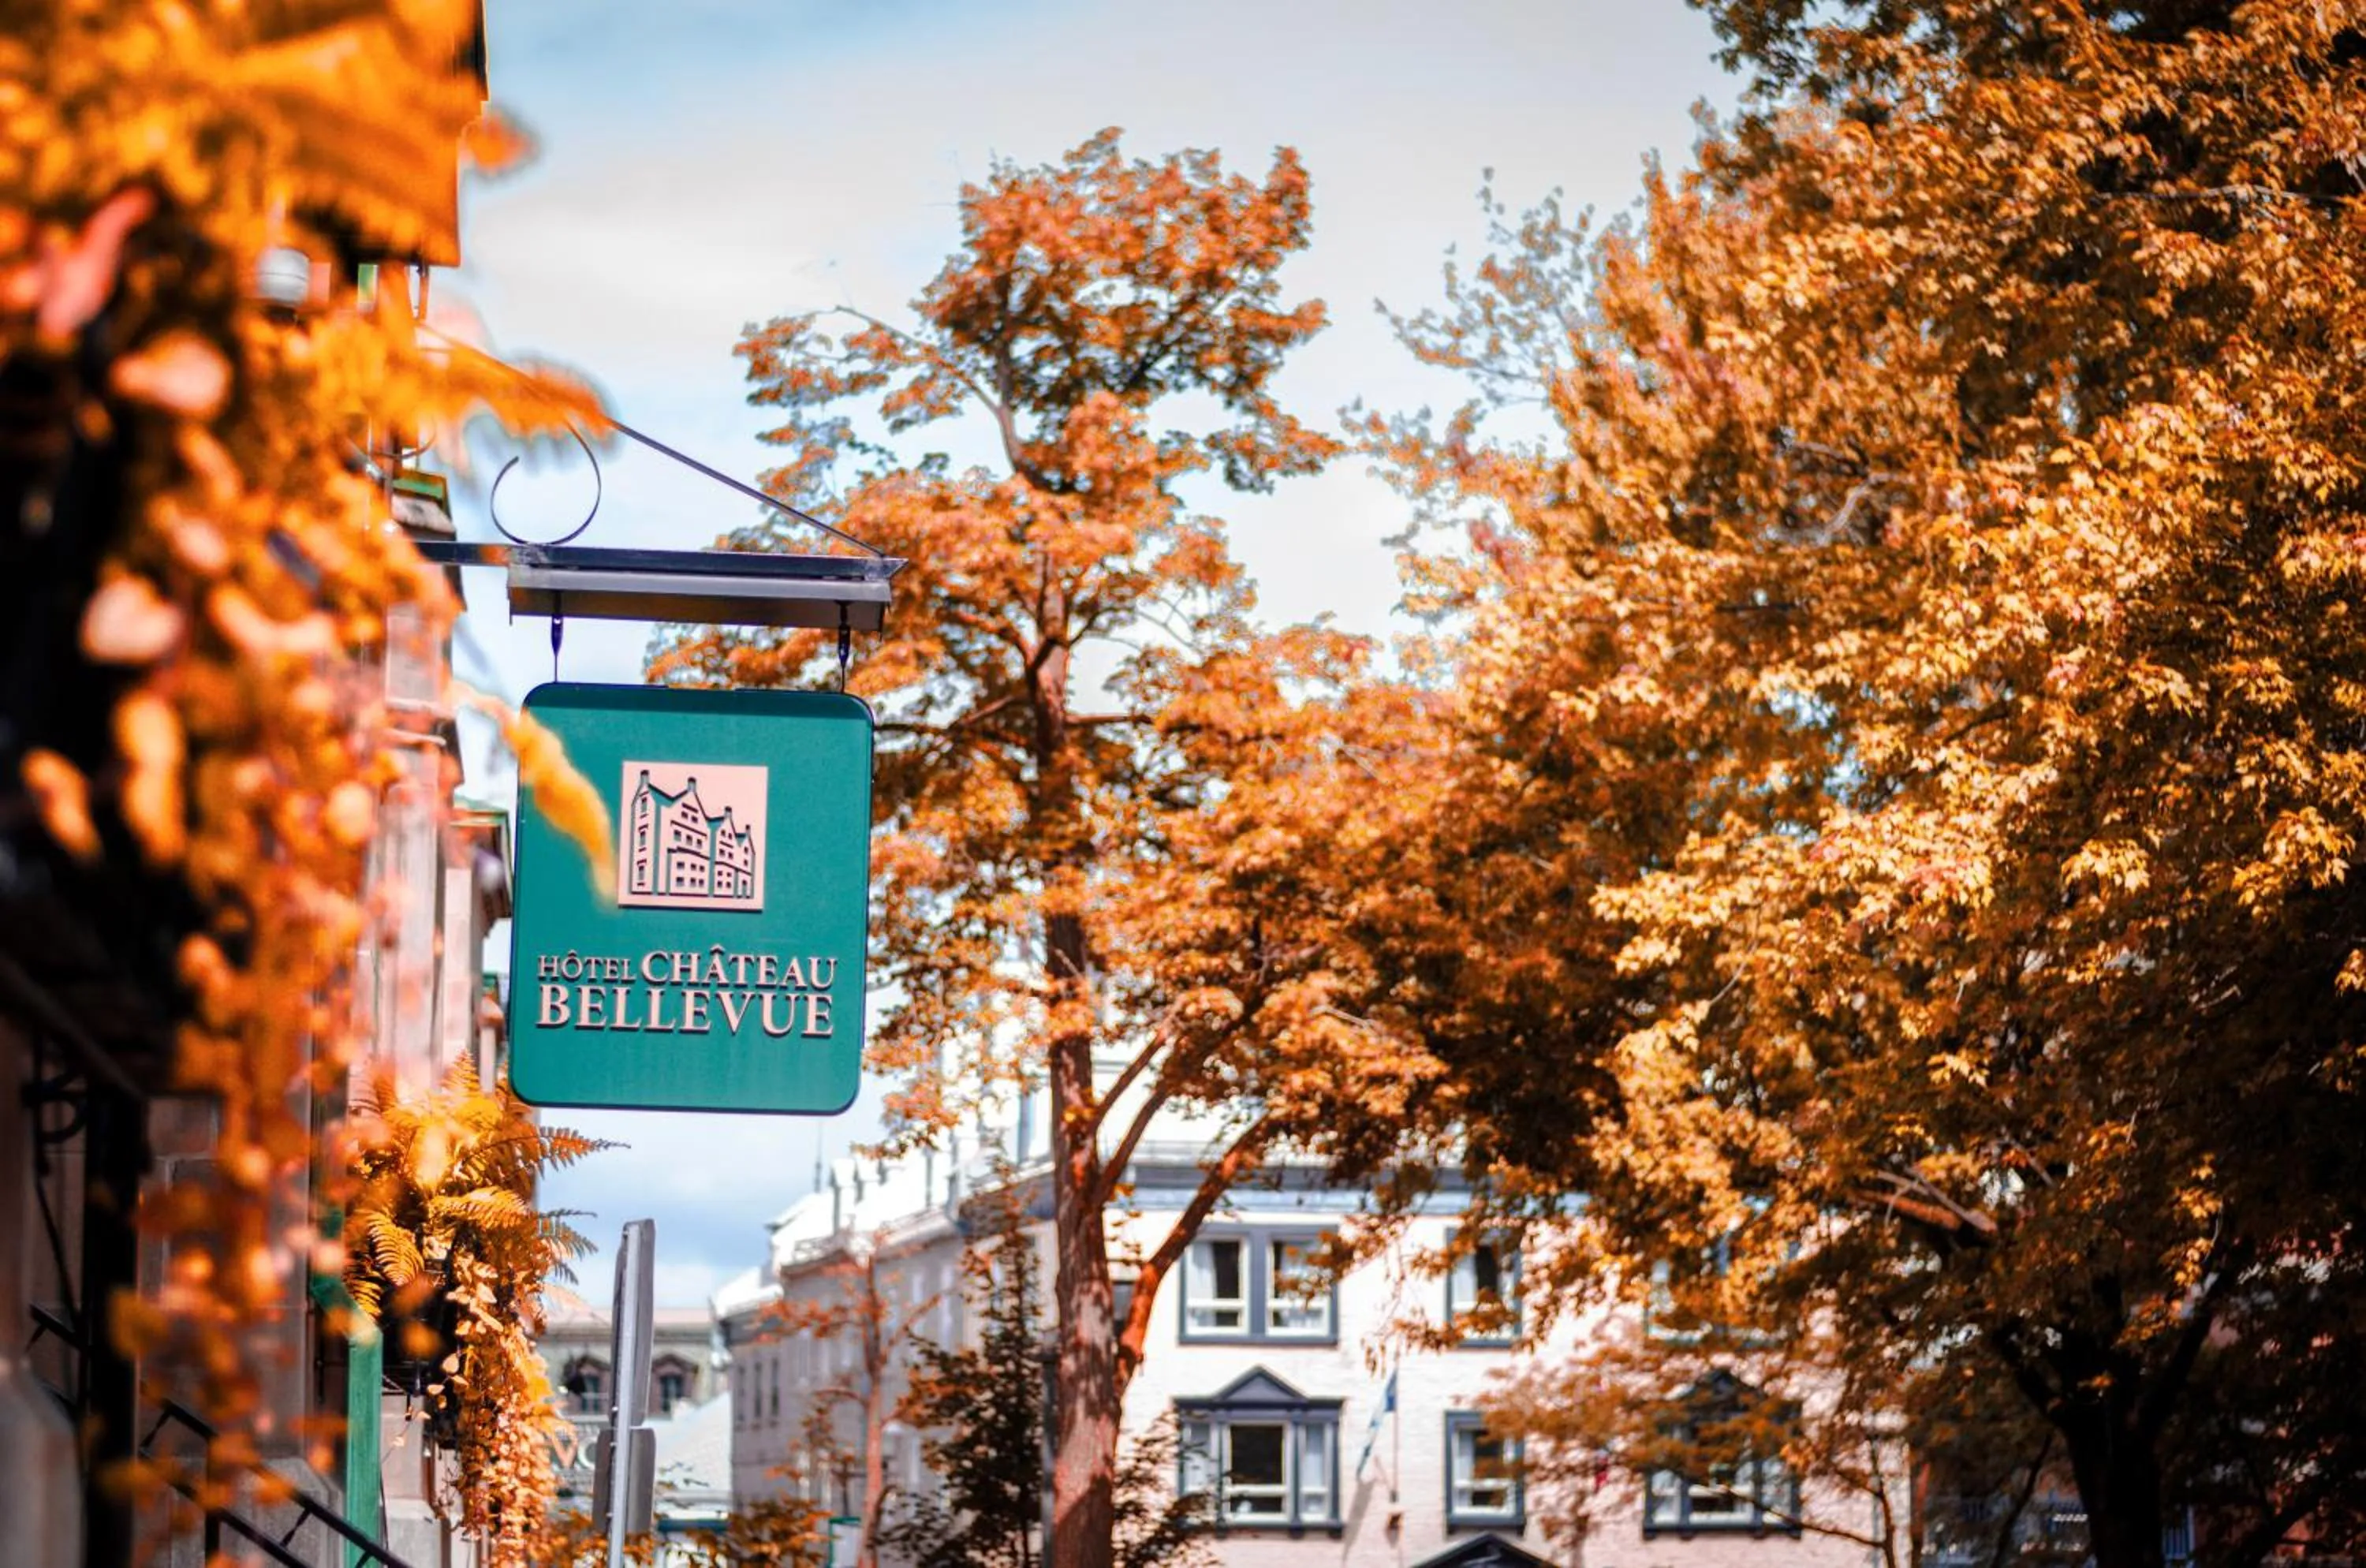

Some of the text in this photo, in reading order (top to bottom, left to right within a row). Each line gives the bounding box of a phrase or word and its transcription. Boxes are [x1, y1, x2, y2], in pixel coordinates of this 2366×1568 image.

[538, 944, 838, 990] HÔTEL CHÂTEAU
[536, 984, 834, 1037] BELLEVUE
